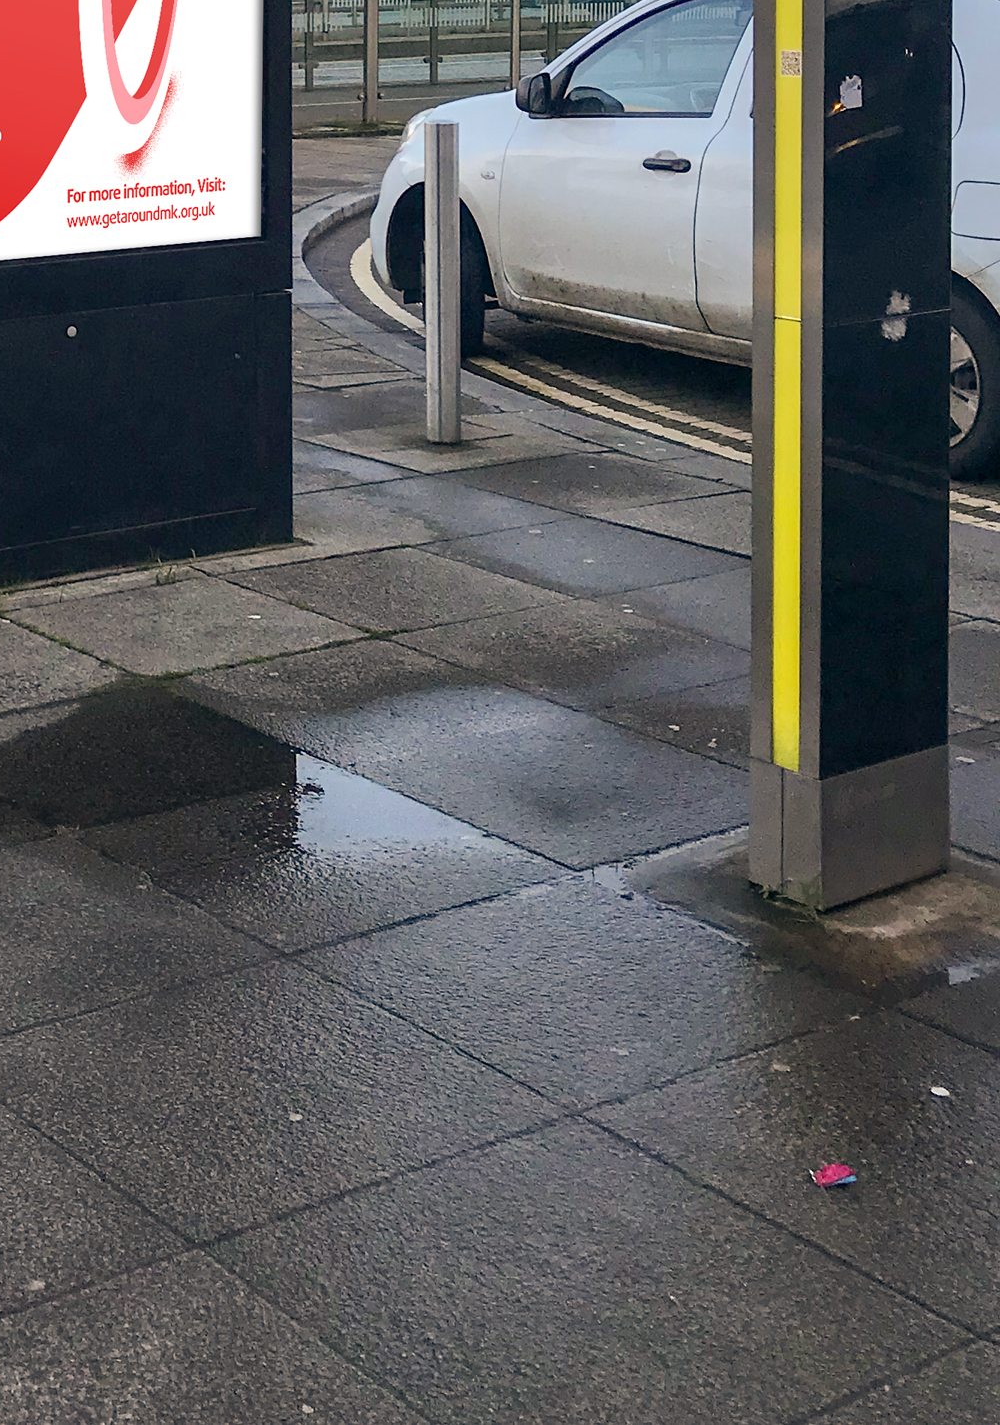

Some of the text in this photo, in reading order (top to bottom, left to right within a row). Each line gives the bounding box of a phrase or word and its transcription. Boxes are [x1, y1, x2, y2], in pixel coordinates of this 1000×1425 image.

[67, 177, 226, 203] For more information, Visit:
[66, 201, 216, 229] www.getaroundmk.org.uk
